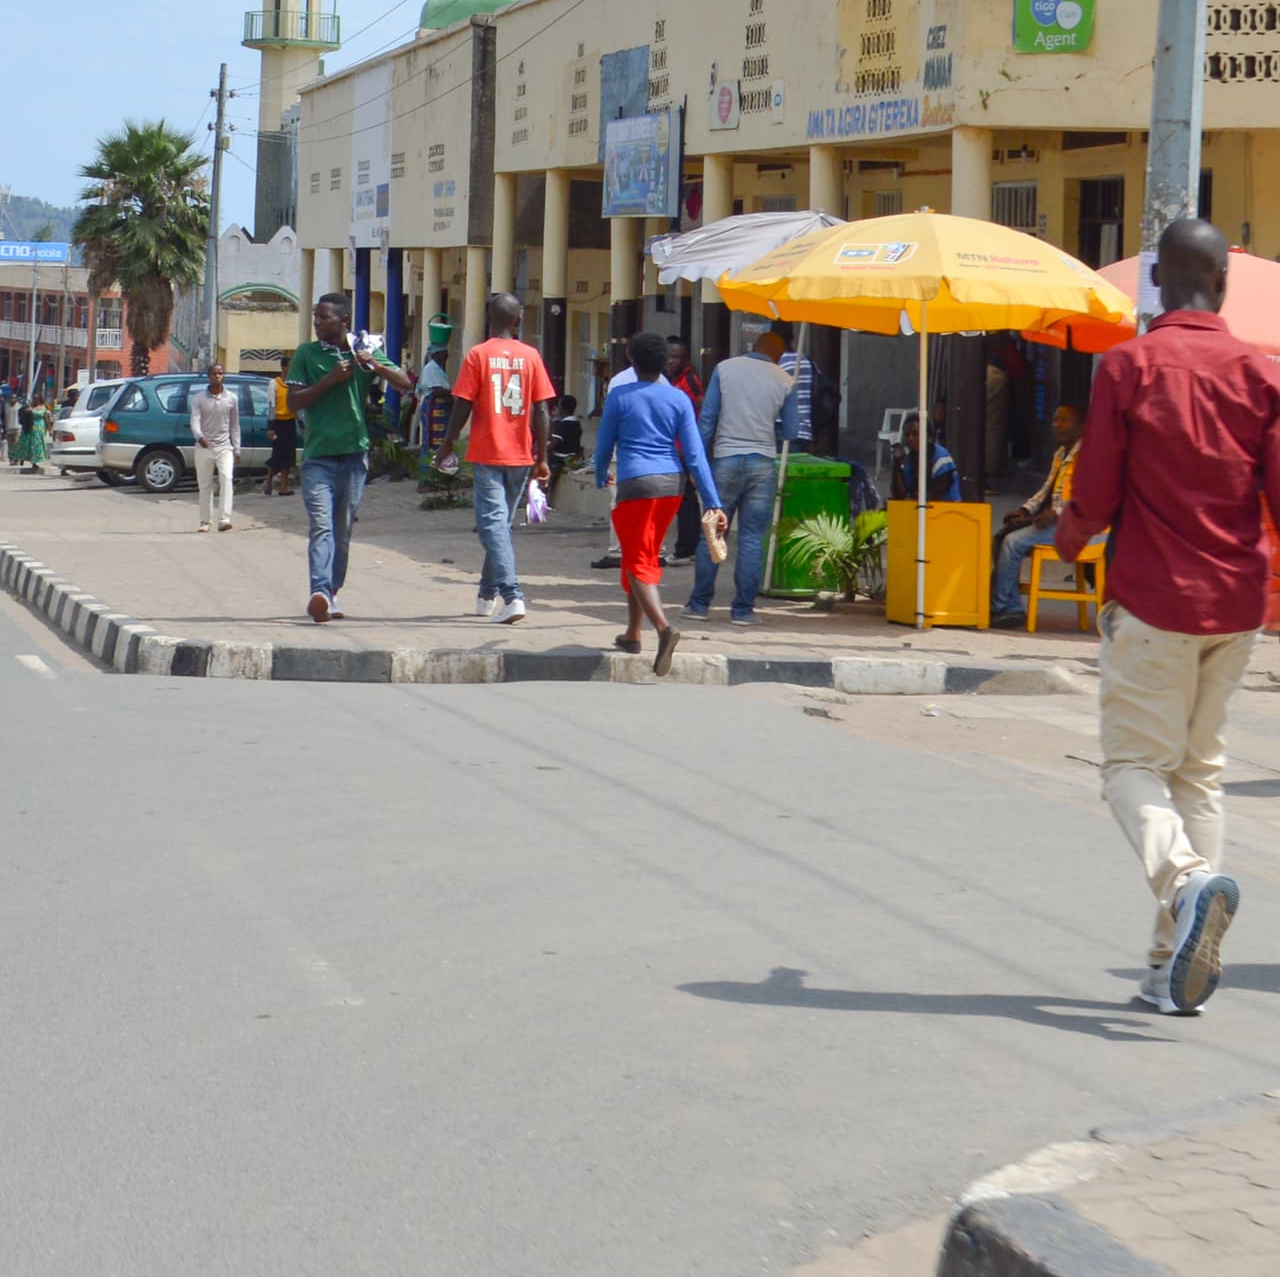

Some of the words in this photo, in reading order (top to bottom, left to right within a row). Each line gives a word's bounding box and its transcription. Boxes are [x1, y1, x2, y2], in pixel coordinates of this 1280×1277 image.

[1035, 0, 1055, 15] tigo
[926, 25, 947, 51] CHEZ
[1035, 32, 1078, 50] Agent
[837, 104, 867, 136] AGIRA
[869, 97, 919, 133] GITEREKA
[491, 371, 524, 415] 14
